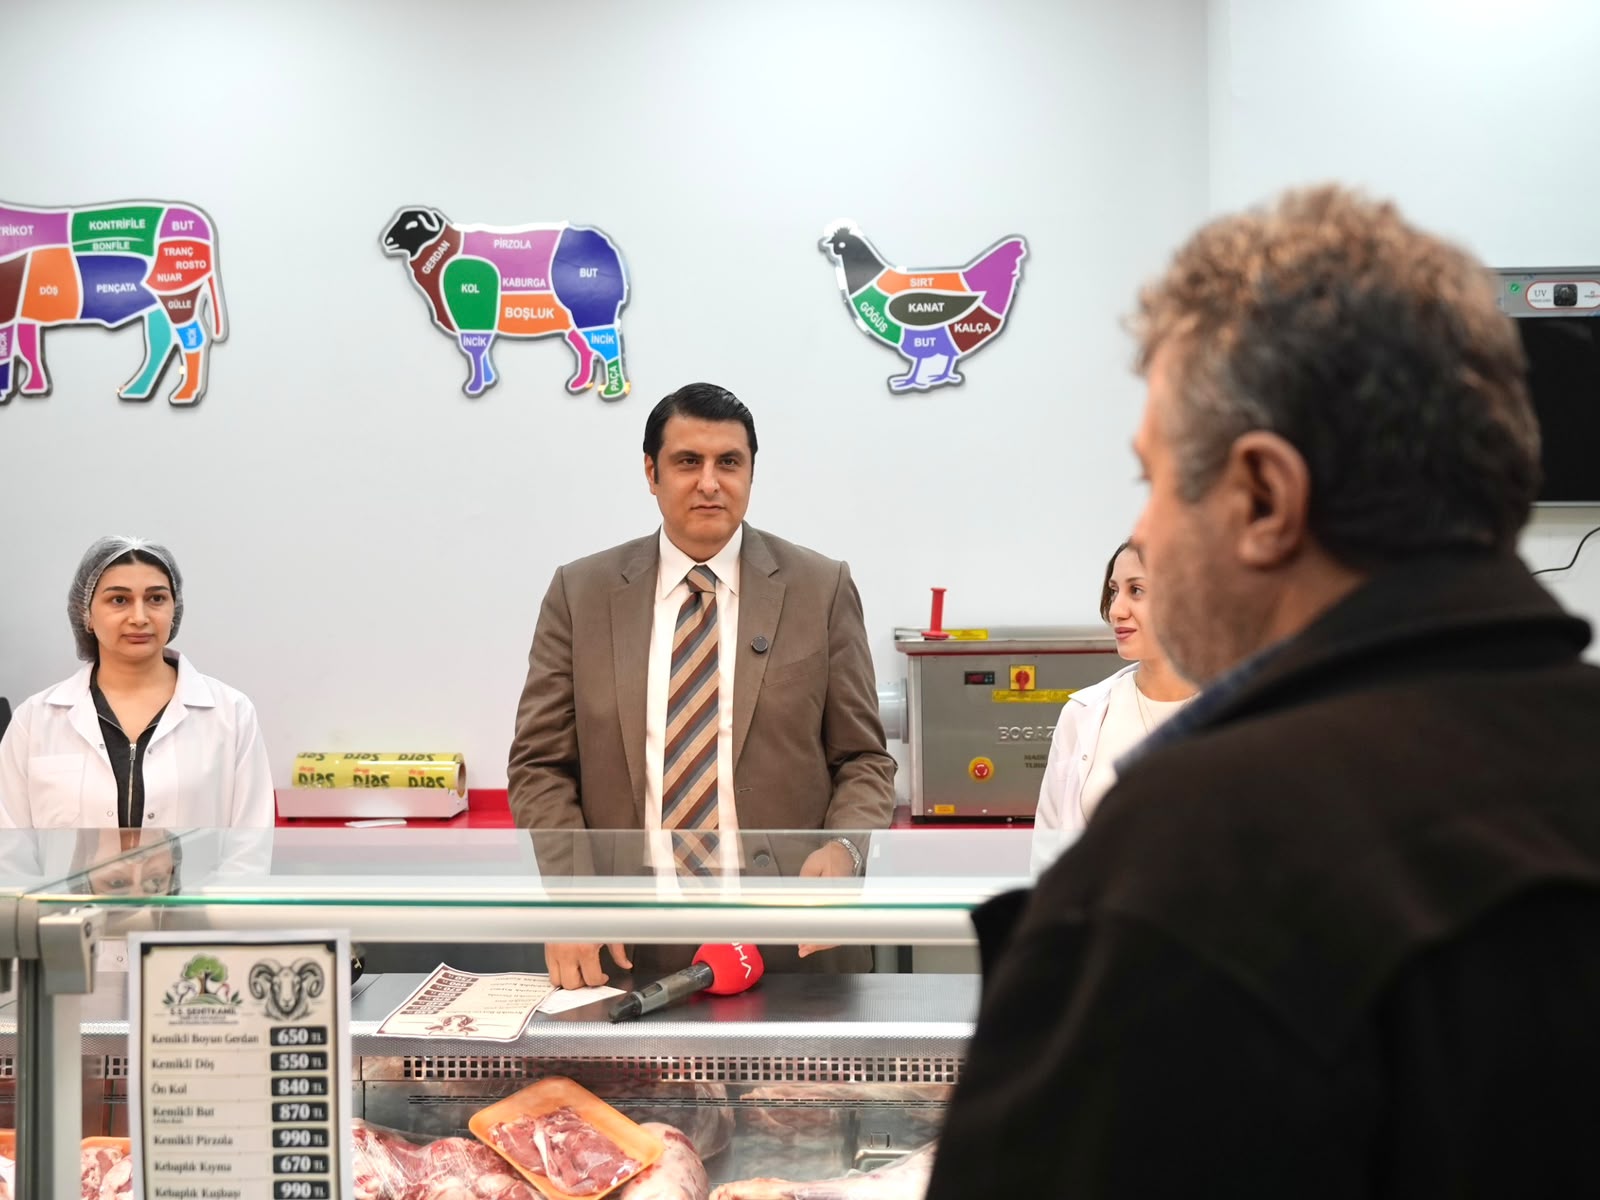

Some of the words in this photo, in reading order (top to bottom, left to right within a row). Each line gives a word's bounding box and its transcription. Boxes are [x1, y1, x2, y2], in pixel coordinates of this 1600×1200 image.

[89, 218, 146, 230] KONTRİFİLE
[172, 220, 194, 231] BUT
[92, 241, 130, 251] BONFİLE
[494, 237, 532, 249] PİRZOLA
[164, 247, 193, 257] TRANÇ
[422, 240, 451, 275] GERDAN
[176, 260, 206, 269] ROSTO
[157, 273, 182, 282] NUAR
[580, 268, 598, 278] BUT
[96, 283, 137, 294] PENÇATA
[461, 283, 480, 293] KOL
[502, 277, 546, 288] KABURGA
[910, 278, 934, 287] SIRT
[39, 285, 58, 296] DÖŞ
[168, 299, 192, 309] GÜLLE
[908, 302, 945, 312] KANAT
[505, 307, 555, 321] BOŞLUK
[954, 323, 992, 335] KALÇA
[463, 334, 487, 347] İNCİK
[591, 333, 615, 345] İNCİK
[914, 337, 936, 347] BUT
[610, 365, 620, 391] PAÇA
[732, 942, 752, 979] HA
[152, 1033, 189, 1043] Kemikli
[192, 1033, 222, 1046] Boyun
[225, 1033, 259, 1043] Gerdan
[278, 1028, 309, 1044] 650
[152, 1058, 192, 1069] Kemikli
[279, 1053, 309, 1069] 550
[170, 1083, 187, 1094] Kol
[279, 1079, 310, 1095] 840
[153, 1106, 193, 1116] Kemikli
[197, 1106, 215, 1116] But
[280, 1104, 310, 1120] 870
[154, 1134, 194, 1145] Kemikli
[196, 1134, 233, 1145] Pirzola
[280, 1130, 311, 1146] 990
[281, 1155, 311, 1172] 670
[281, 1182, 312, 1198] 990
